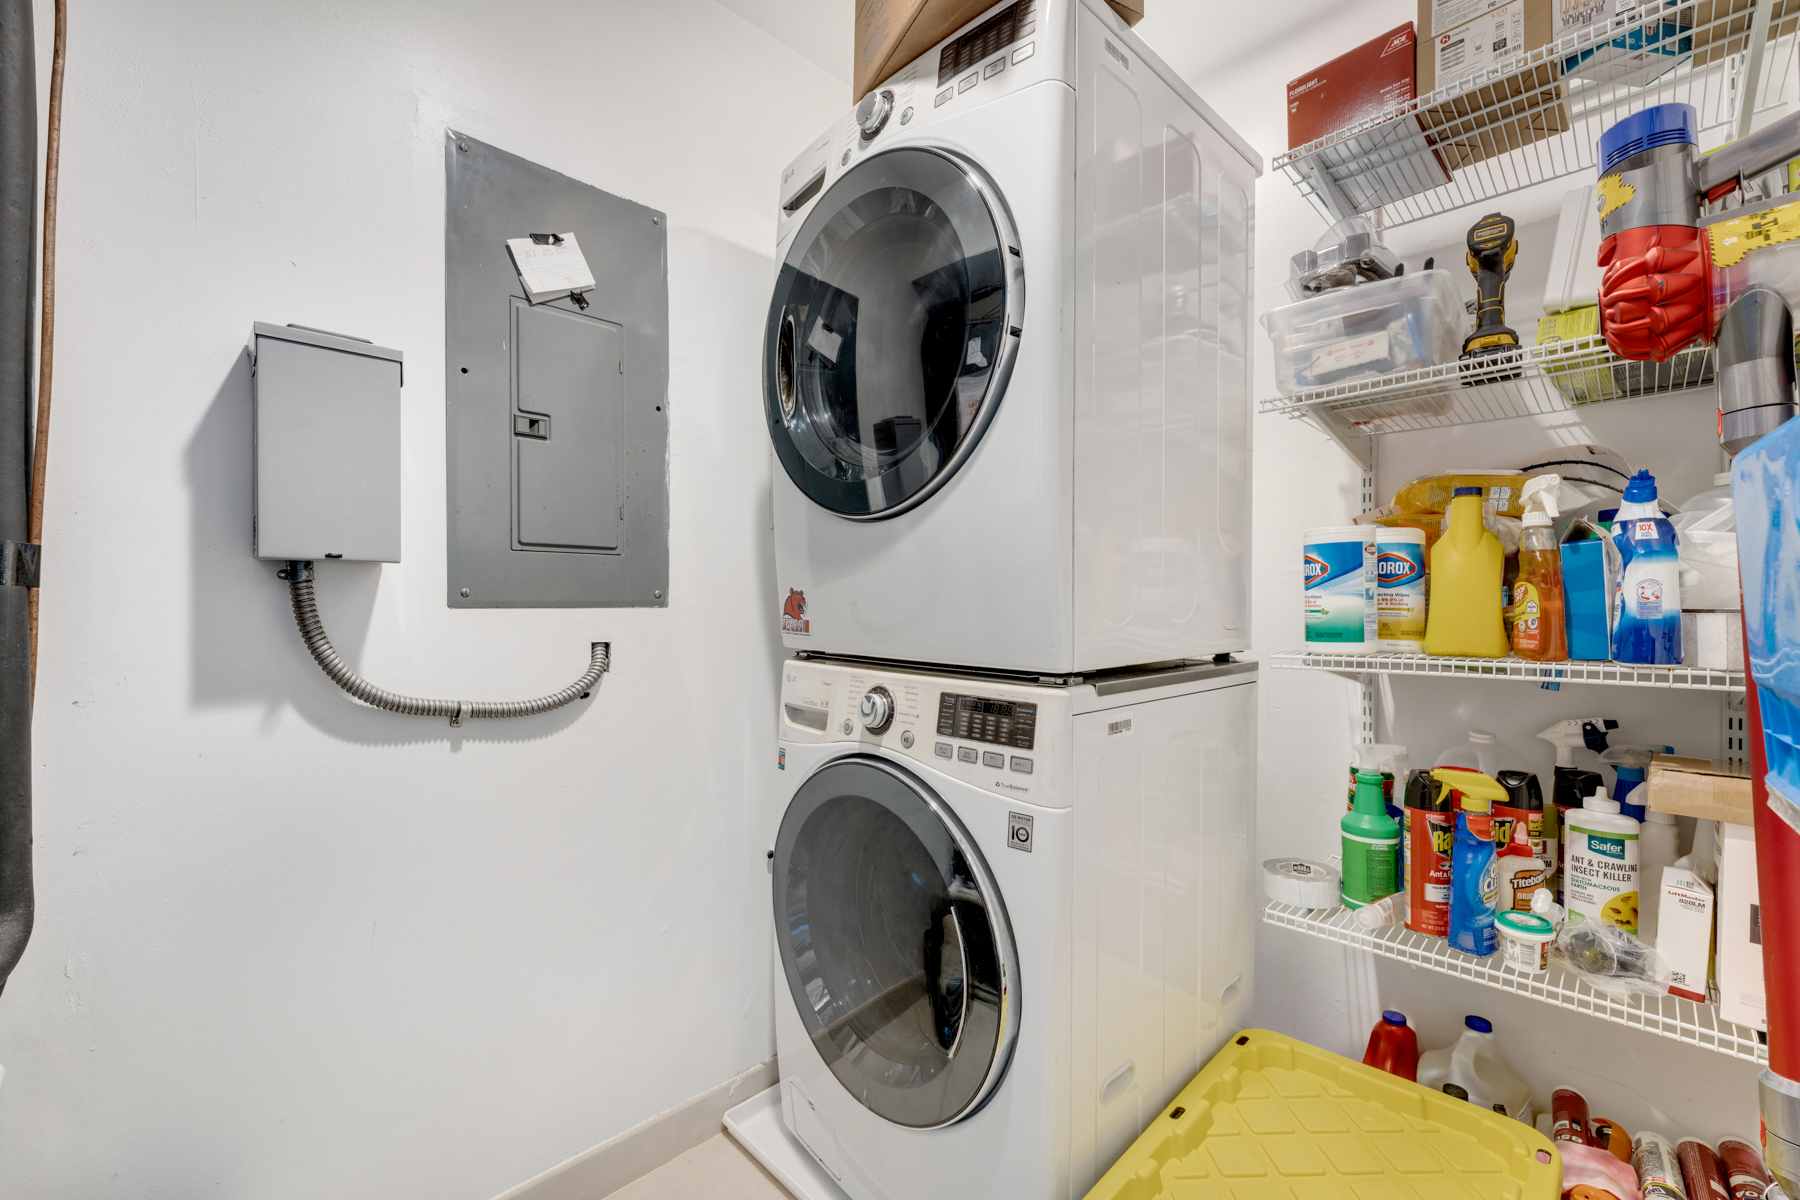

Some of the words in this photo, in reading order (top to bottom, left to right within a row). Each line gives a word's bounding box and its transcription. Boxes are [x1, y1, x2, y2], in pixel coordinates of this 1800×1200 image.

[1391, 34, 1407, 47] ACE
[1289, 78, 1318, 97] FLOODLIGHT
[1638, 523, 1654, 532] 10X
[1011, 824, 1030, 843] 10
[1591, 840, 1622, 853] Safer
[1571, 854, 1585, 865] ANT
[1587, 858, 1594, 868] &
[1597, 860, 1638, 873] CRAWLING
[1429, 870, 1444, 878] Ant
[1571, 863, 1600, 878] INSECT
[1603, 871, 1632, 882] KILLER
[1570, 877, 1621, 892] DIATOMACEOUS
[1570, 881, 1587, 891] EARTH
[1668, 890, 1706, 903] LiftMaster
[1679, 898, 1706, 909] 828LM
